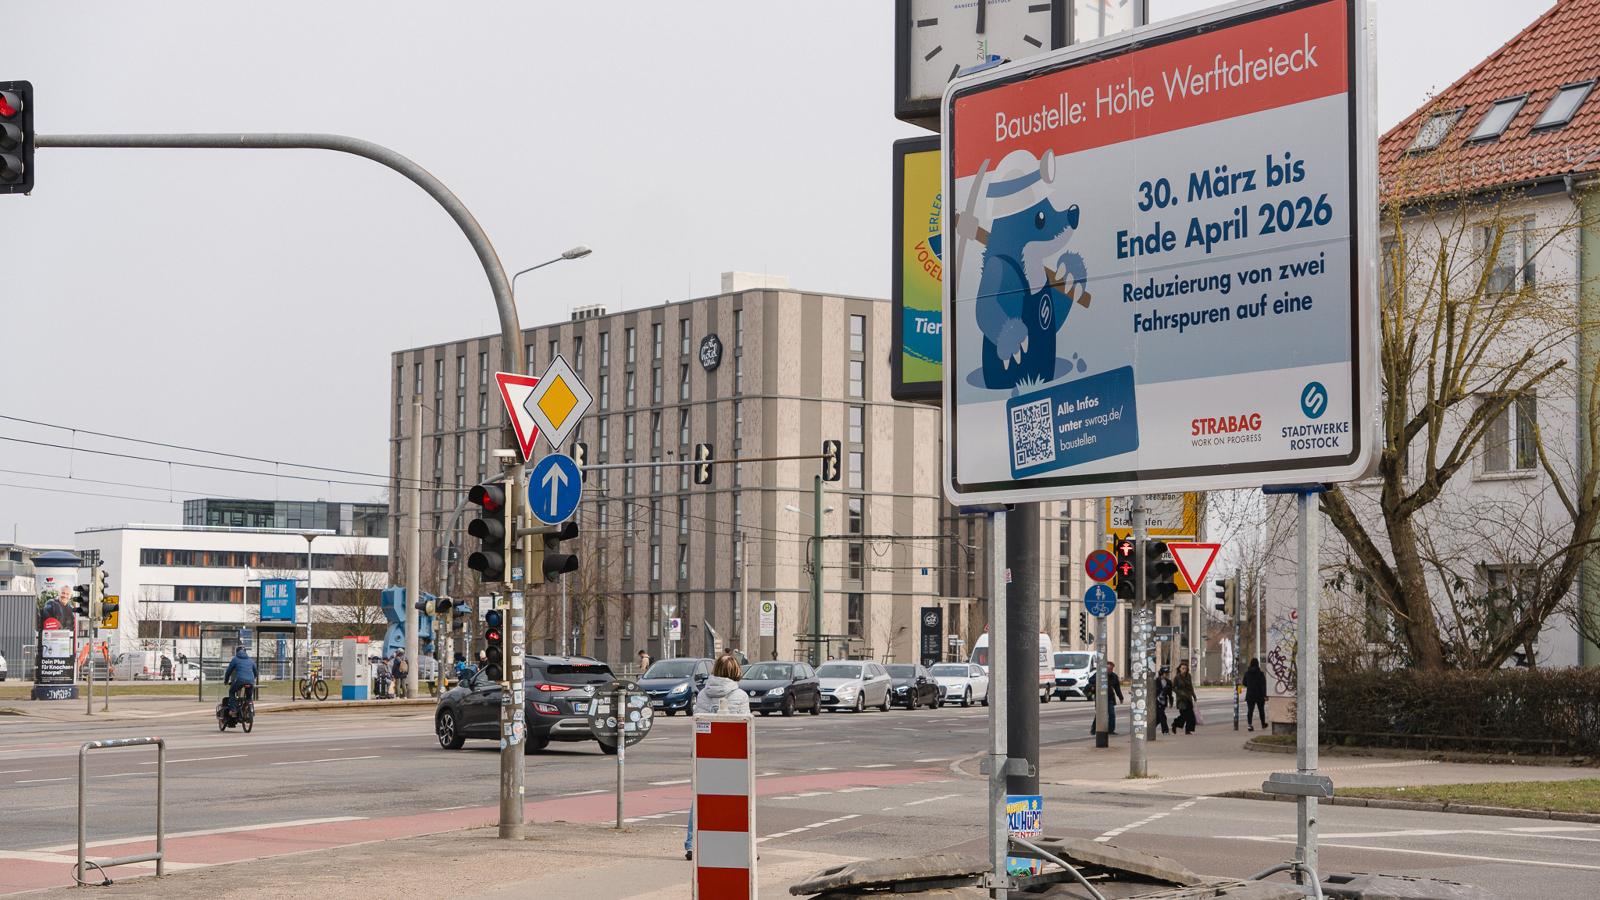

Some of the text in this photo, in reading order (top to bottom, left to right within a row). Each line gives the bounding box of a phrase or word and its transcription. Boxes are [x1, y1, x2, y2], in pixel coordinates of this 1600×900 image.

[995, 32, 1319, 142] Baustelle: Höhe Werftdreieck
[1138, 151, 1305, 212] 30. März bis
[1116, 193, 1333, 259] Ende April 2026
[1123, 251, 1325, 303] Reduzierung von zwei
[1134, 291, 1313, 333] Fahrspuren auf eine
[1057, 396, 1099, 416] Alle Infos
[1058, 404, 1124, 434] unter swrag.de/
[1191, 412, 1262, 436] STRABAG
[1281, 421, 1349, 438] STADTWERKE
[1060, 433, 1097, 451] baustellen
[1191, 434, 1262, 447] WORK ON PROGRESS
[1290, 436, 1340, 450] ROSTOCK
